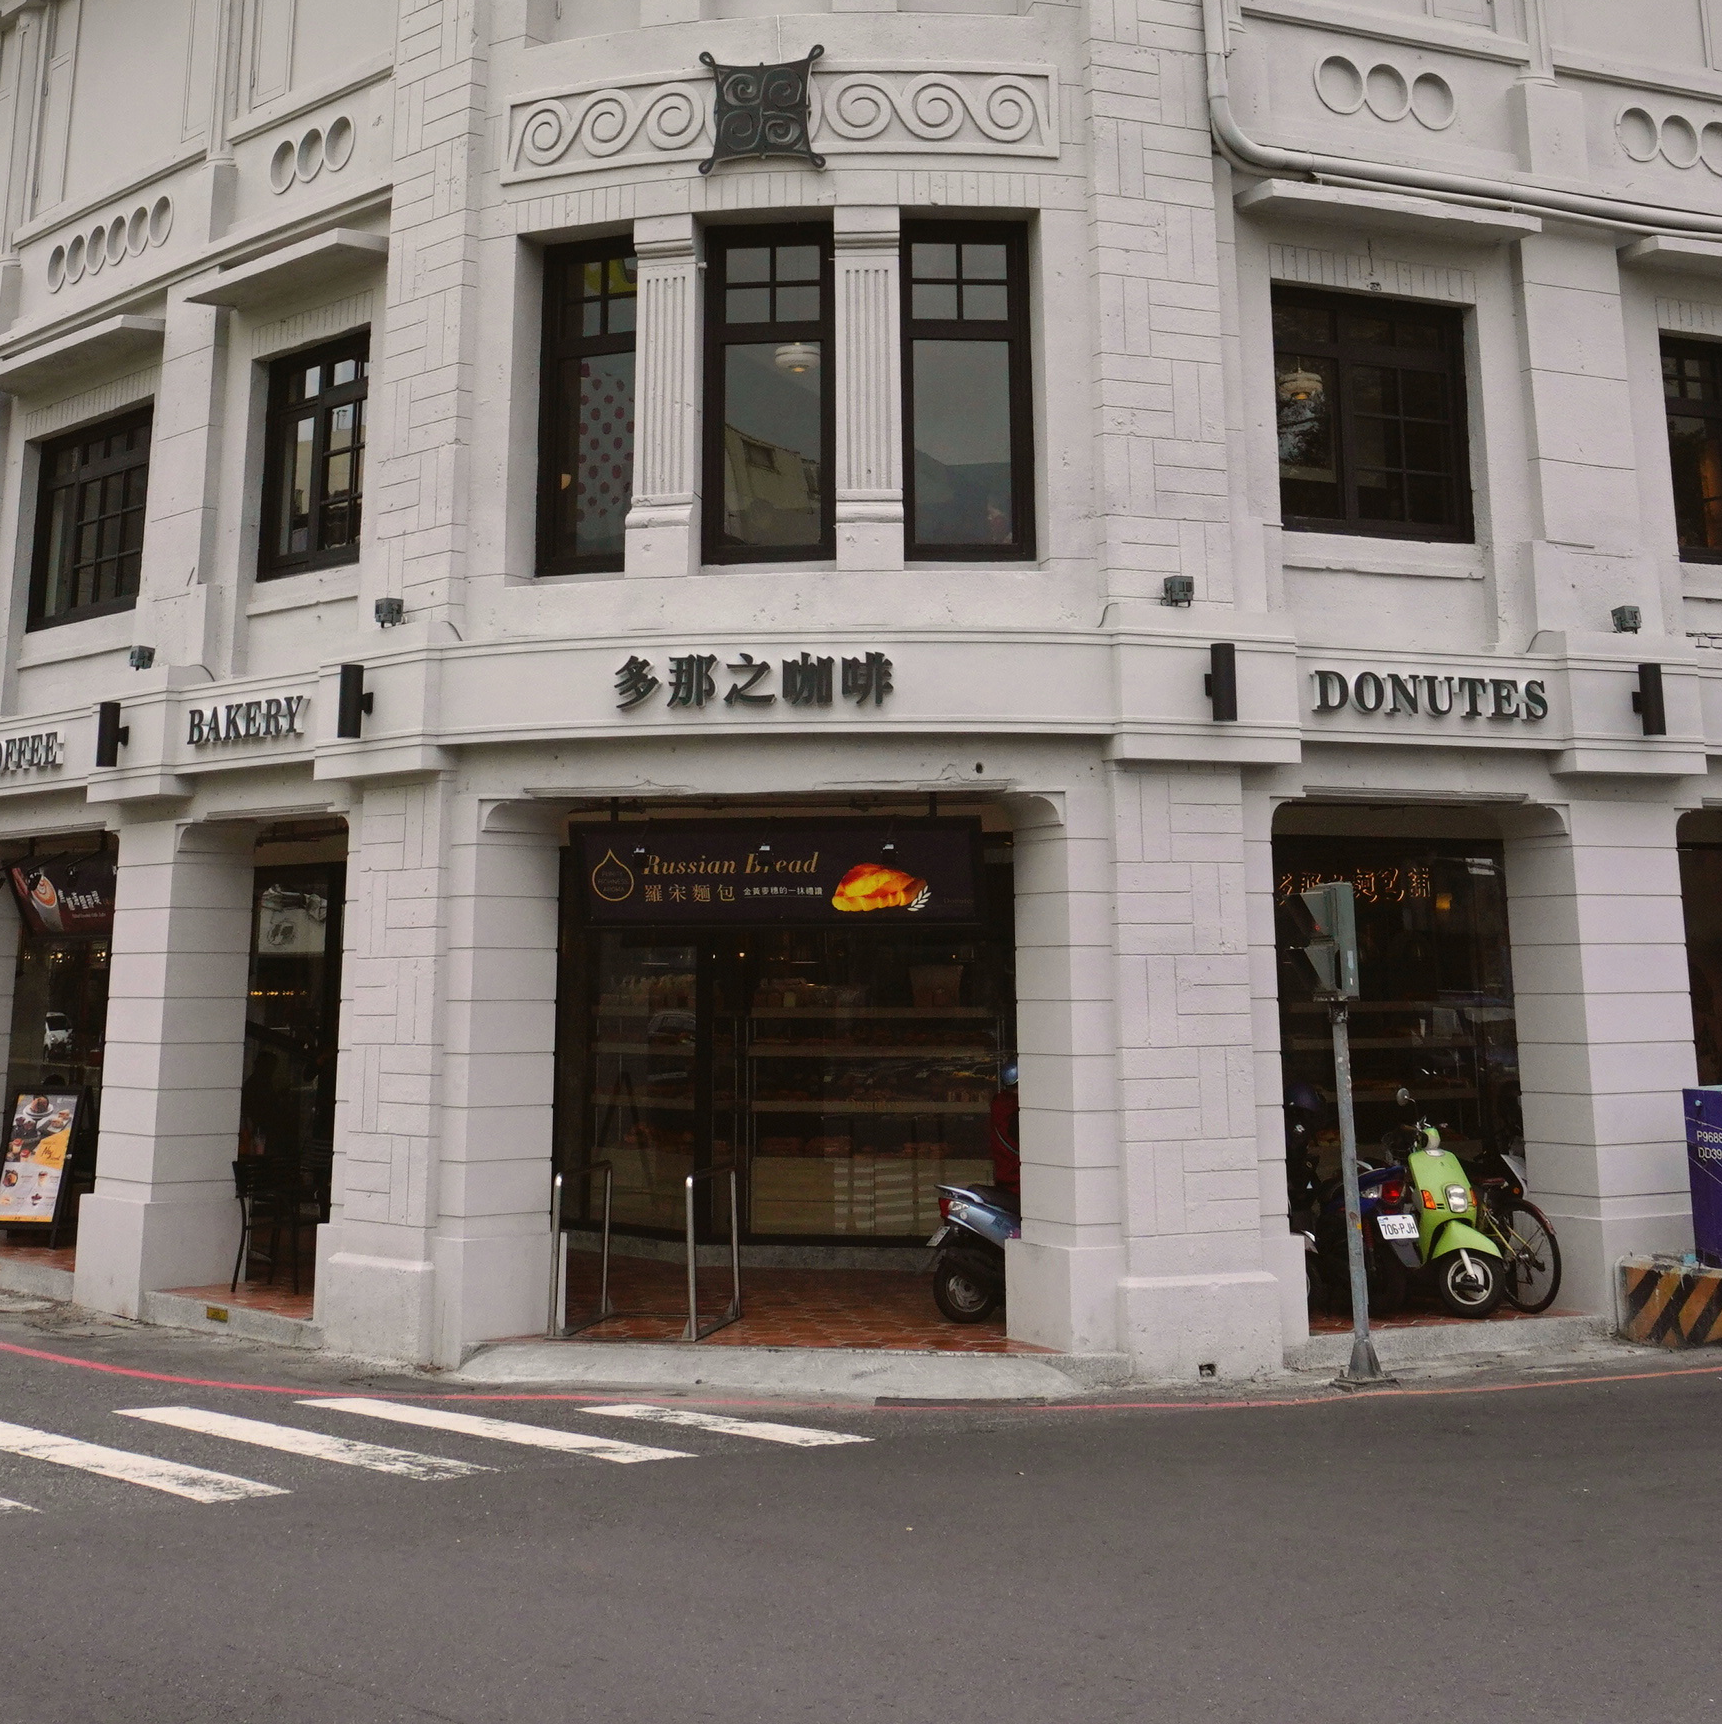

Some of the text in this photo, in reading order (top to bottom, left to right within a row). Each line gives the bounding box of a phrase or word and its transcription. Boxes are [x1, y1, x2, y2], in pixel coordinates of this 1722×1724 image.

[614, 652, 895, 709] 多那之咖啡
[1314, 669, 1550, 721] DONUTES
[187, 696, 305, 746] BAKERY
[642, 853, 737, 876] Russian
[644, 883, 736, 903] 羅宋麵包
